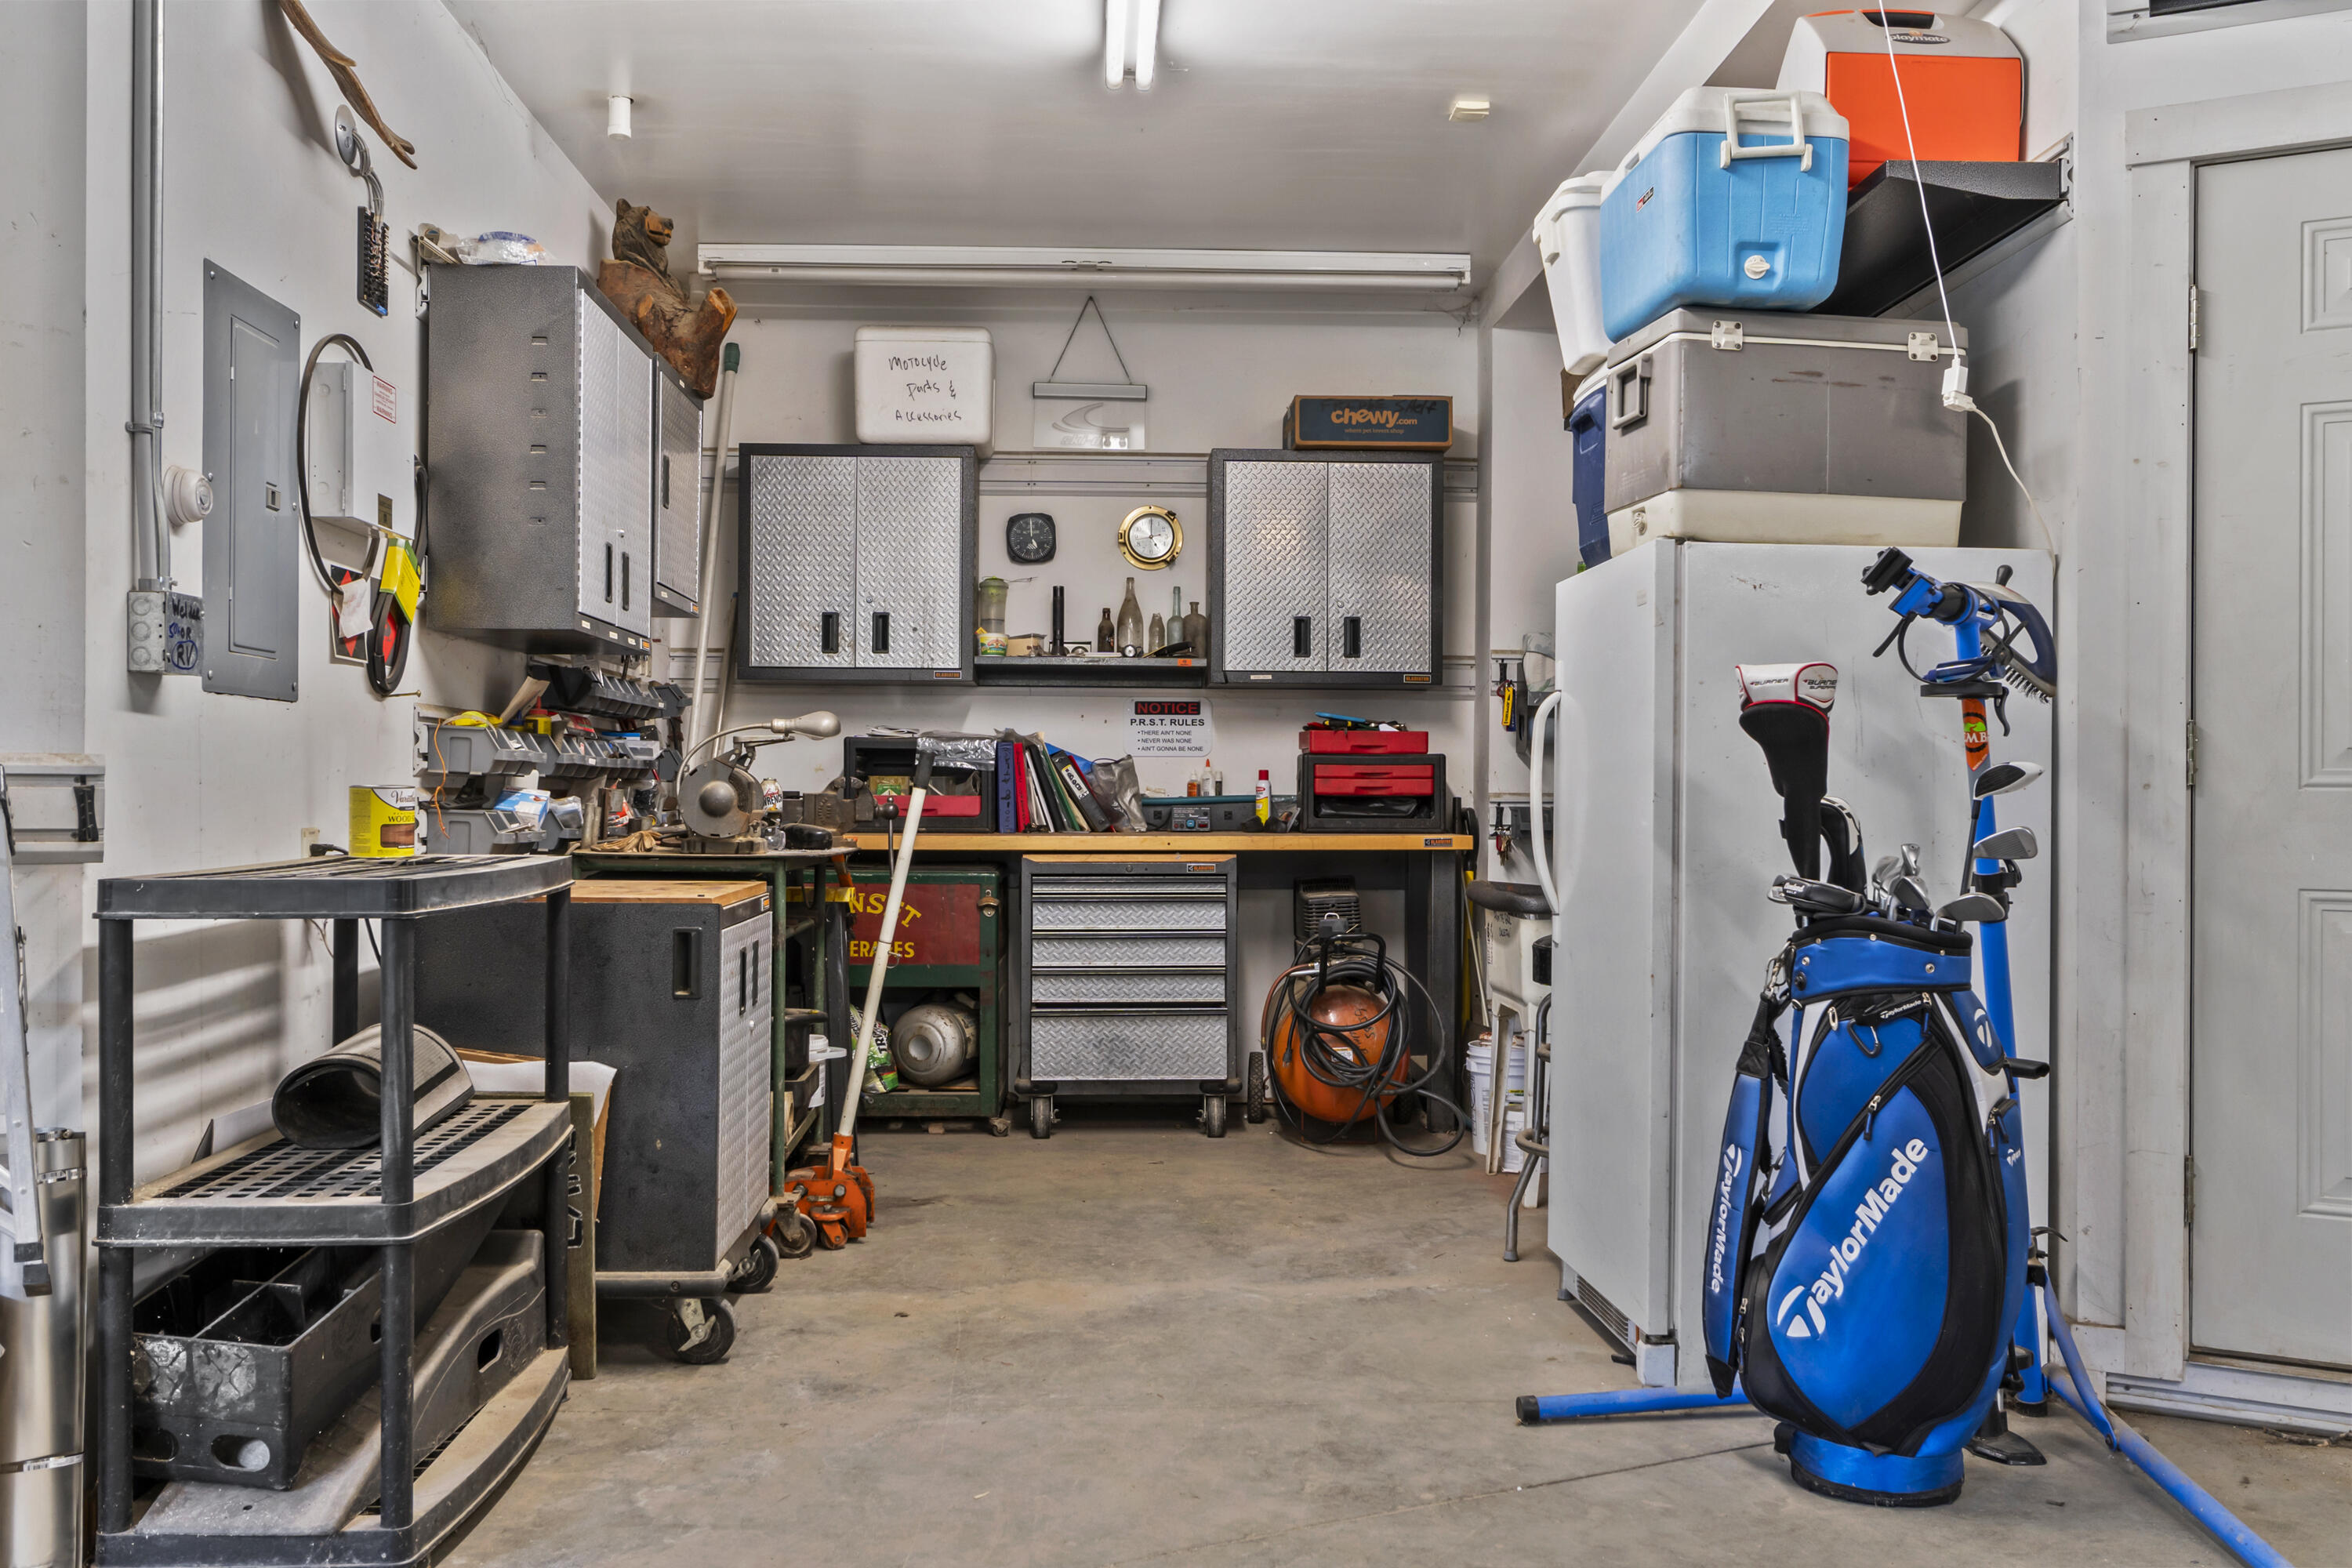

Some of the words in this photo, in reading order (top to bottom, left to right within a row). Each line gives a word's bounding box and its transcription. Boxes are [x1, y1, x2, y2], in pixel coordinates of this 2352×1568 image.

[1889, 34, 1947, 42] playmate
[176, 643, 194, 666] RV
[1137, 702, 1199, 714] NOTICE
[849, 892, 922, 928] NST
[1880, 1000, 1922, 1019] TaylorMade
[1711, 1143, 1743, 1295] TaylorMade
[1777, 1138, 1929, 1339] TaylorMade
